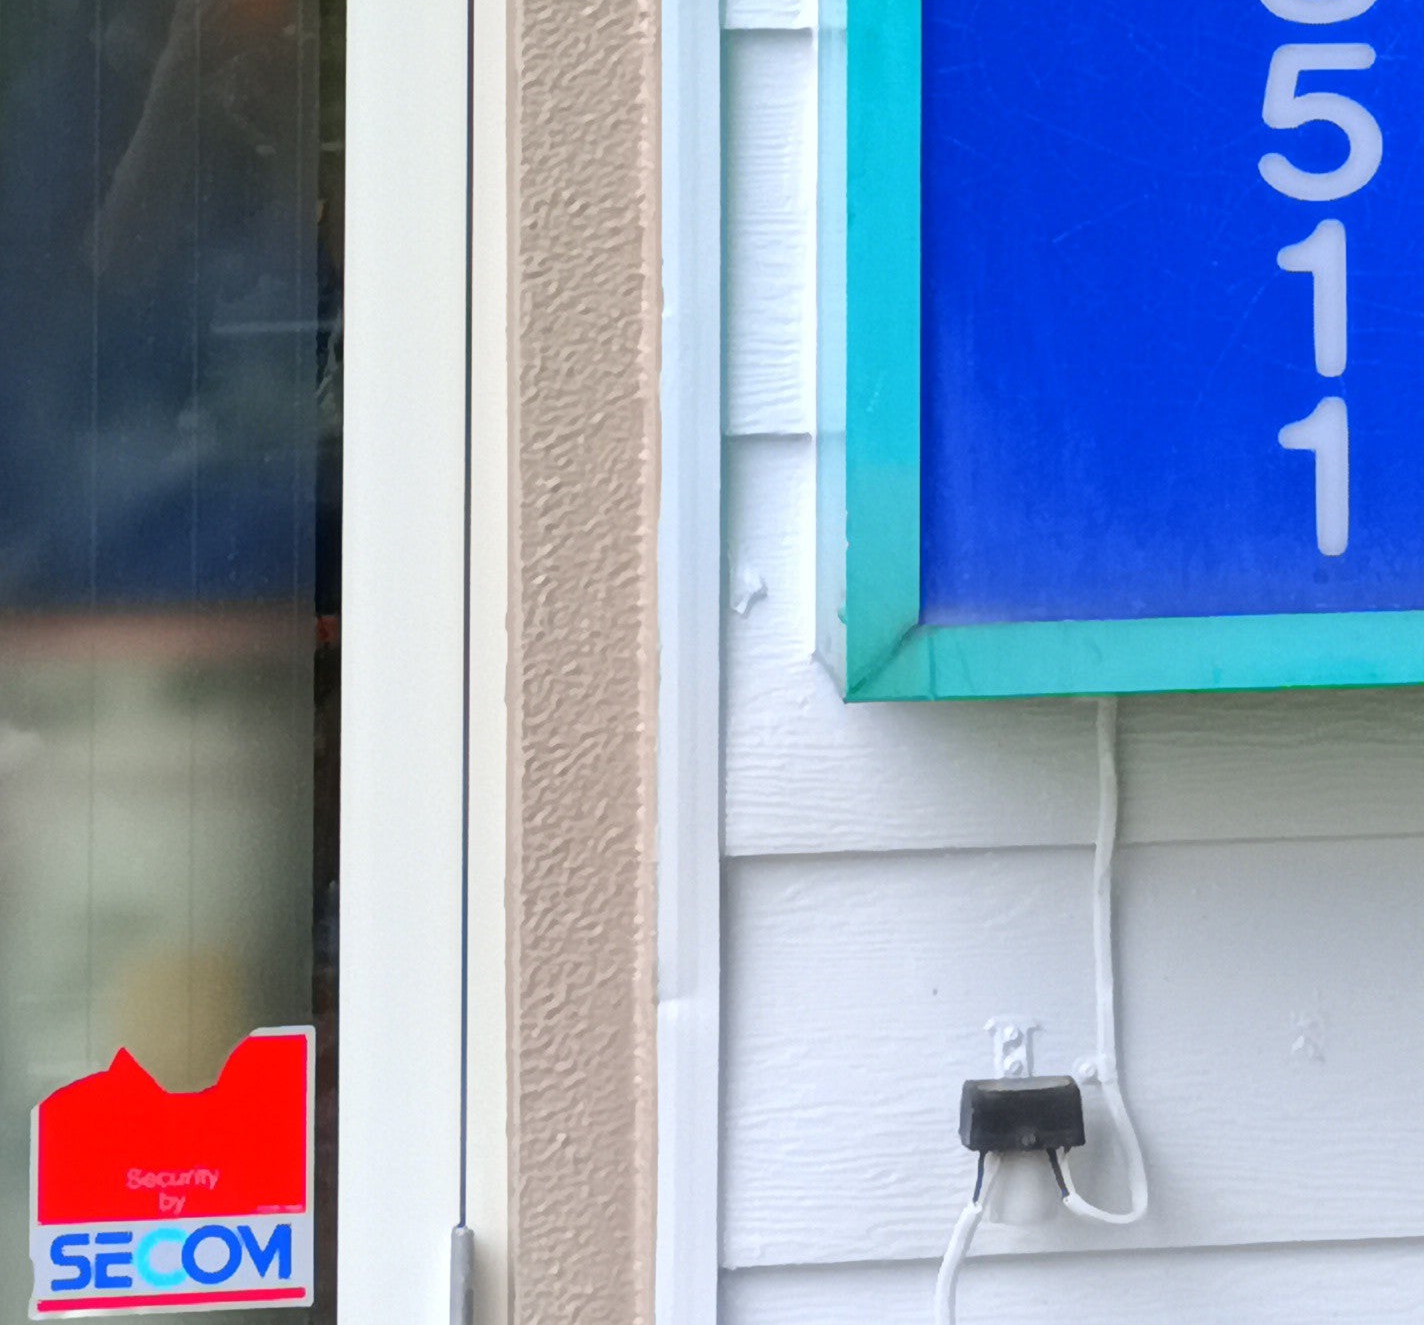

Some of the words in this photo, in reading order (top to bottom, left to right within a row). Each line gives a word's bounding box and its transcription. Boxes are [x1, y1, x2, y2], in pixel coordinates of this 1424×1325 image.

[126, 1168, 219, 1190] Security
[159, 1193, 186, 1215] by
[50, 1224, 292, 1292] SECOM
